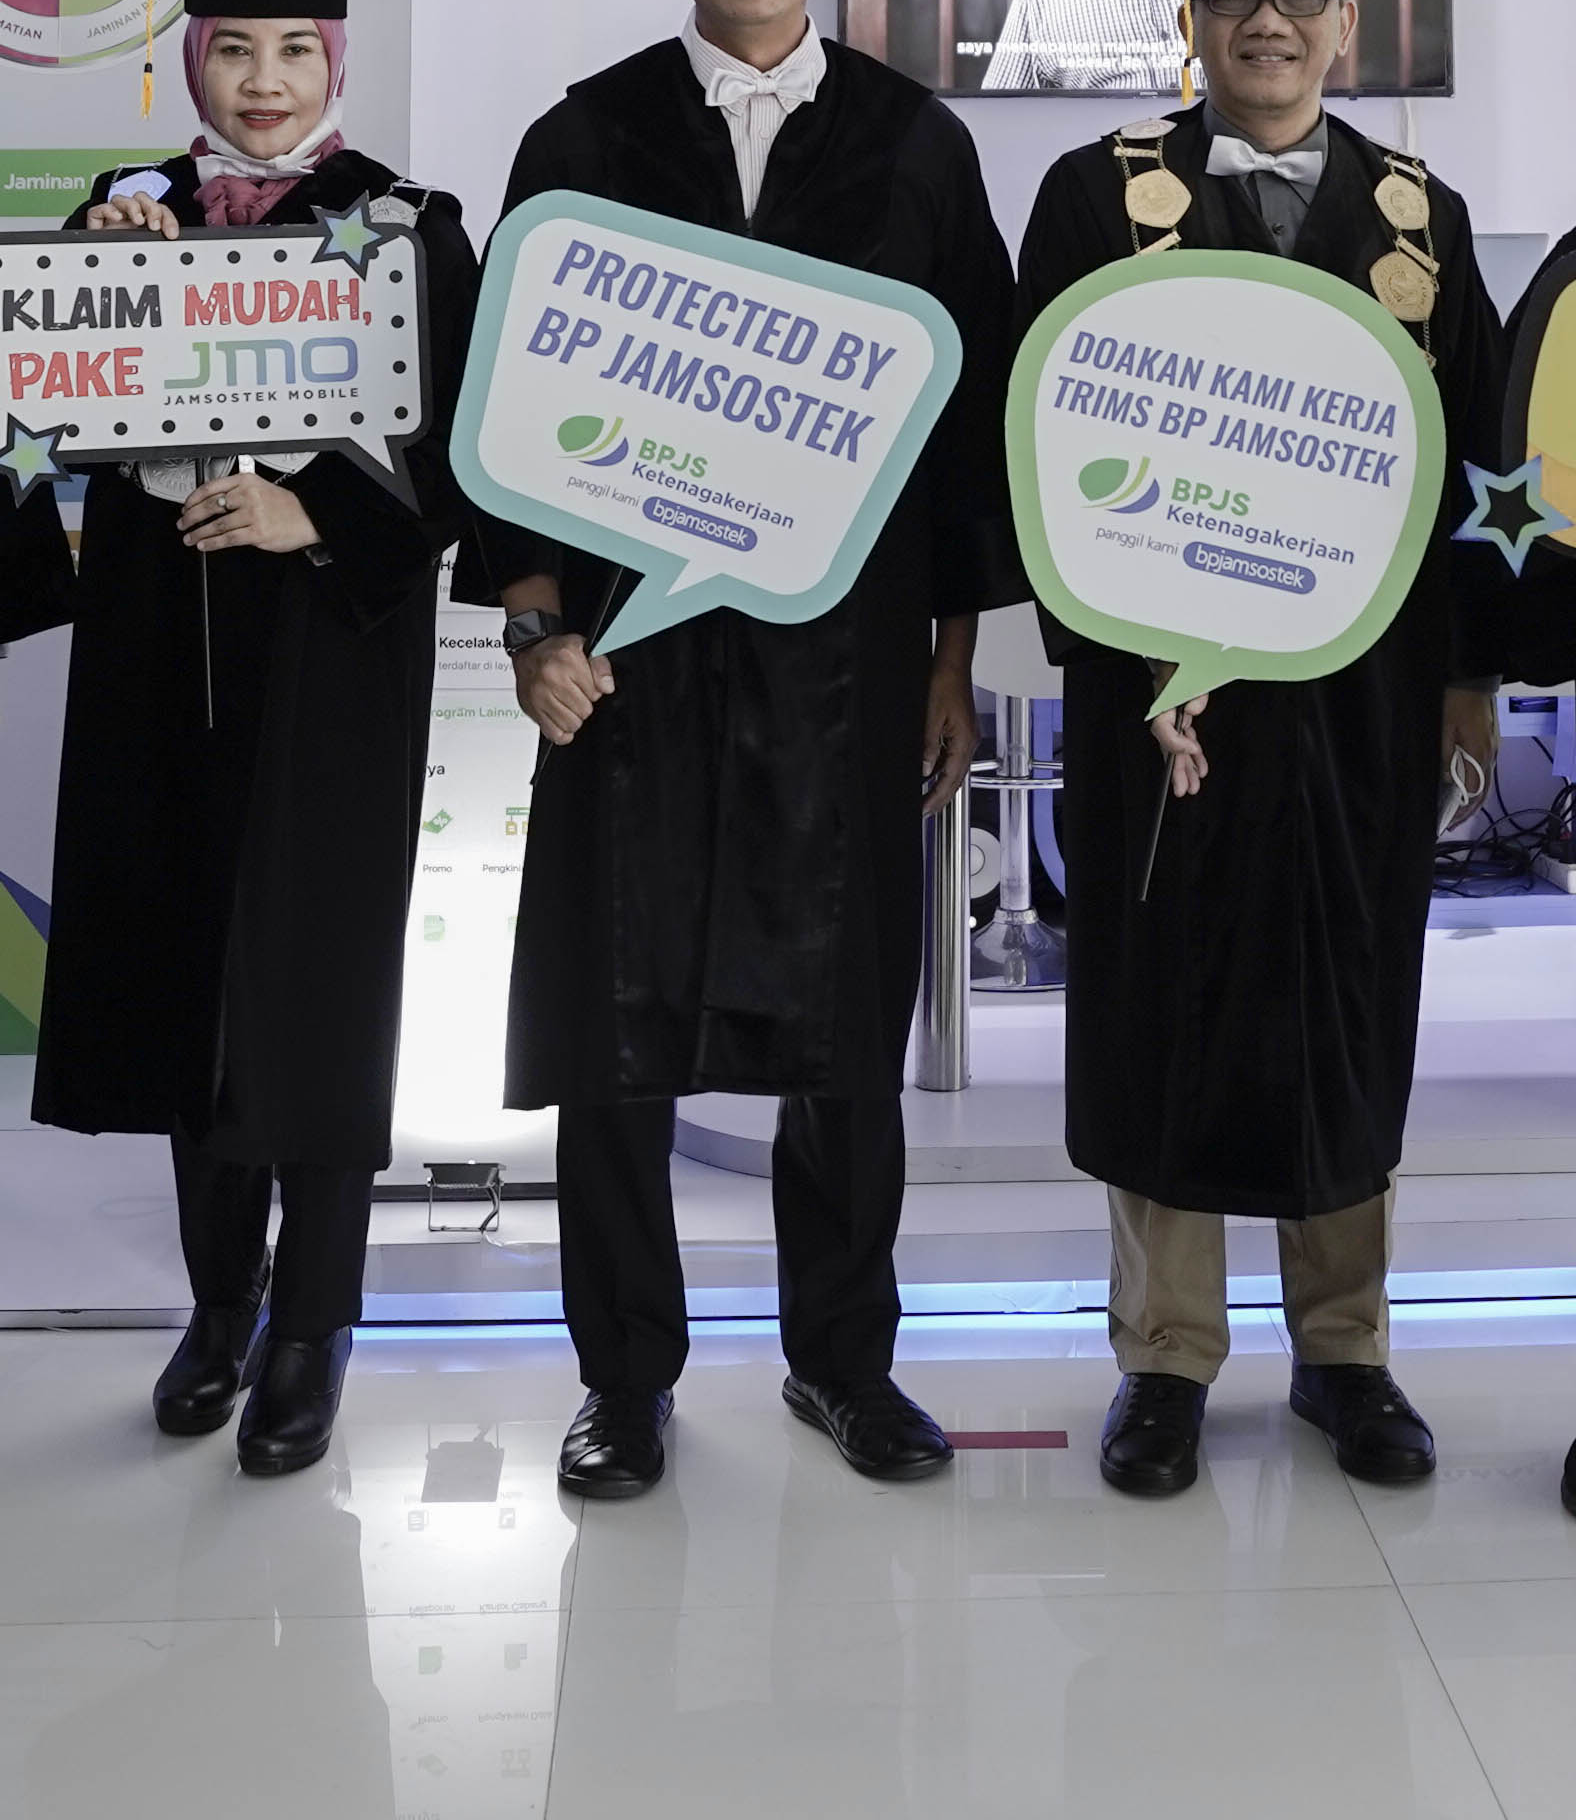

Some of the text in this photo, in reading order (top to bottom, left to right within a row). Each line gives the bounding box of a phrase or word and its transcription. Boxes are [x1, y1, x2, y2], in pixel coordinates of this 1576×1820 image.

[86, 11, 141, 39] JAMINAN
[956, 42, 993, 56] saya
[4, 173, 86, 190] Jaminan
[2, 278, 373, 332] KLAIM MUDAH,
[552, 239, 897, 391] PROTECTED BY
[8, 336, 359, 401] PAKE JMO
[163, 387, 360, 406] JAMSOSTEK MOBILE
[526, 306, 875, 463] BP JAMSOSTEK
[1069, 330, 1398, 438] DOAKAN KAMI KERJA
[638, 438, 709, 478] BPJS
[1053, 375, 1400, 488] TRIMS BP JAMSOSTEK
[567, 474, 749, 547] panggil kami bpjamsostek
[631, 462, 795, 530] Ketenagakerjaan
[1171, 477, 1251, 517] BPJS
[1095, 525, 1305, 589] panggil kami bpjamsostek
[1166, 504, 1356, 565] Ketenagakerjaan
[438, 661, 481, 670] terdaftar
[483, 661, 493, 670] di
[423, 864, 453, 873] Promo
